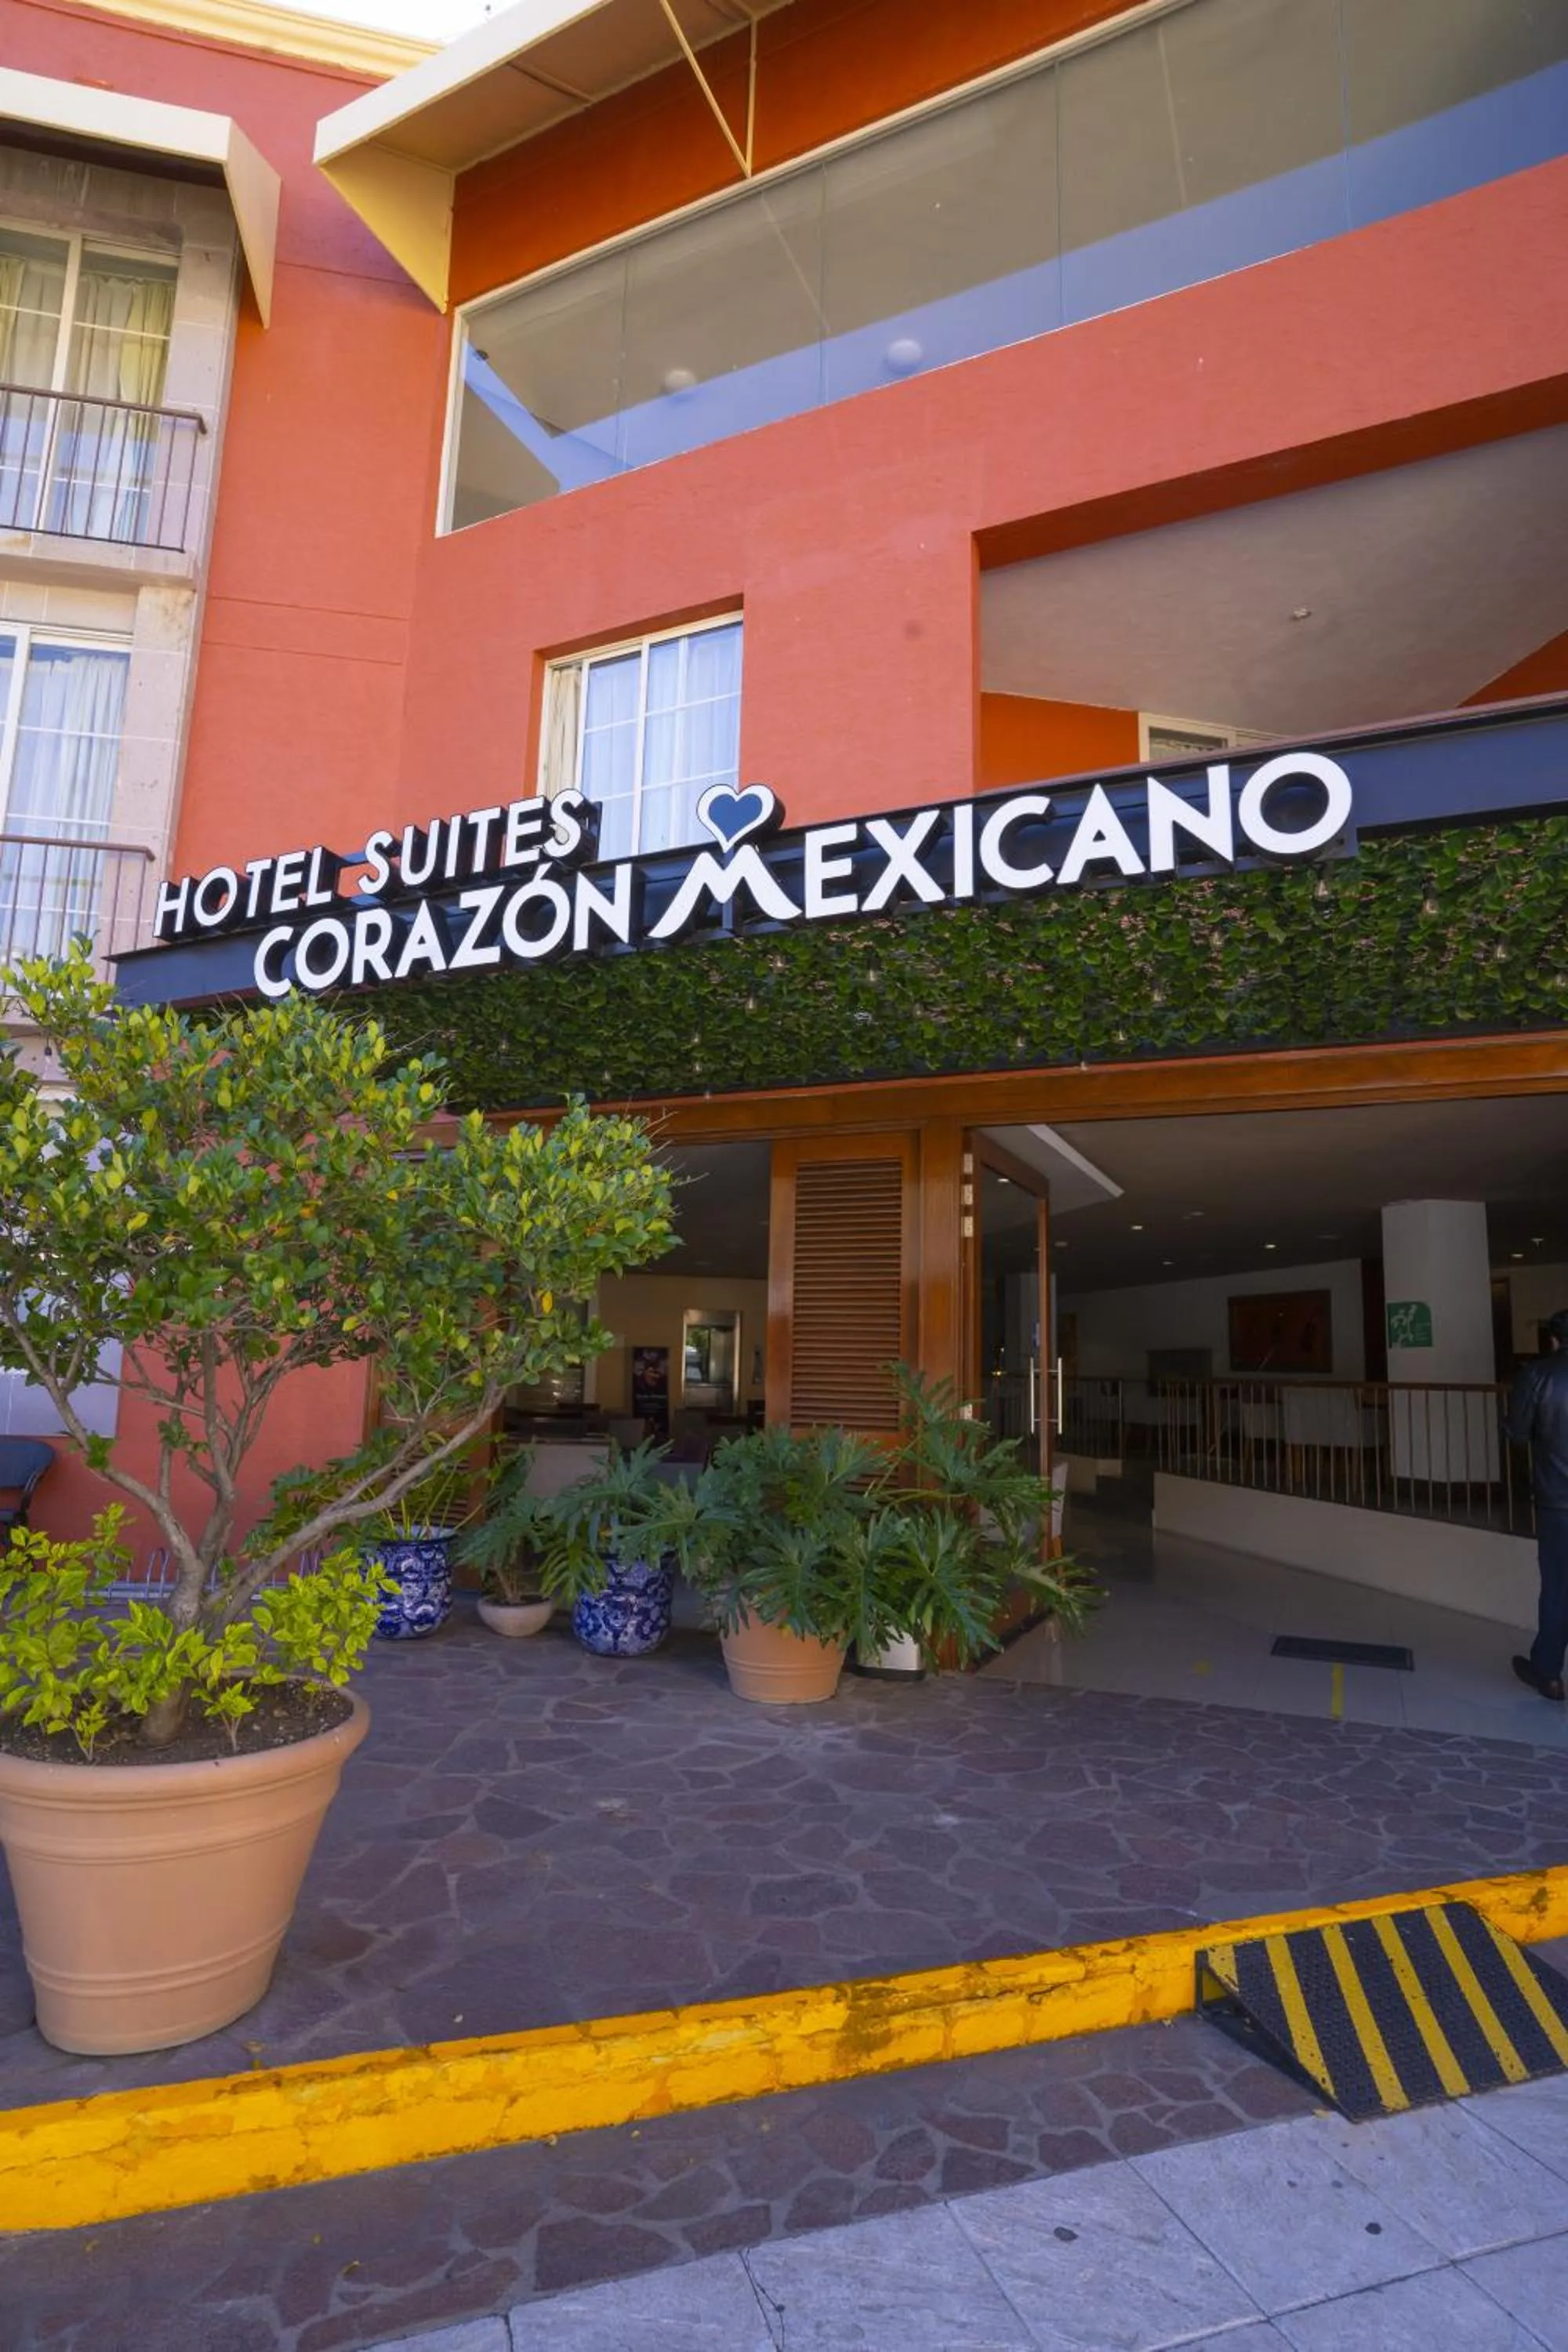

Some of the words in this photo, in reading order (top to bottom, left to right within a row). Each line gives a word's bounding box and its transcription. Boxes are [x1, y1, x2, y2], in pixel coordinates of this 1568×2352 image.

[153, 846, 333, 938] HOTEL
[357, 789, 584, 895] SUITES
[252, 862, 631, 998] CORAZÓN
[648, 752, 1353, 938] MEXICANO
